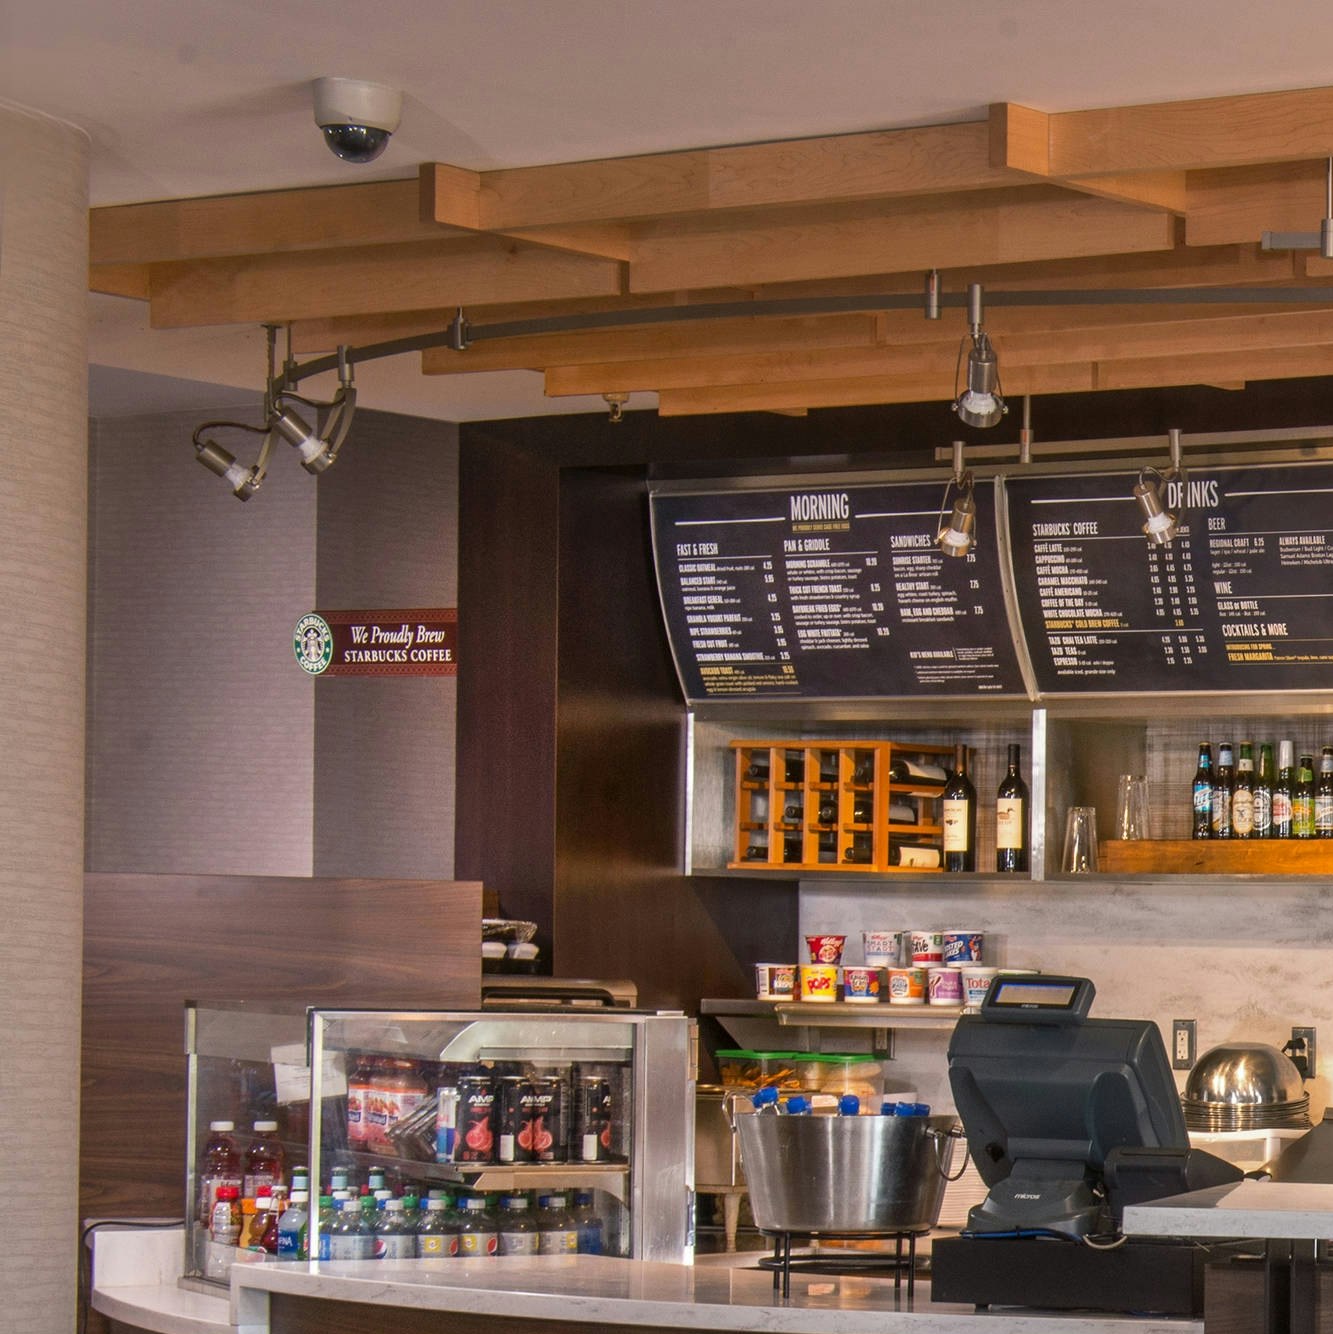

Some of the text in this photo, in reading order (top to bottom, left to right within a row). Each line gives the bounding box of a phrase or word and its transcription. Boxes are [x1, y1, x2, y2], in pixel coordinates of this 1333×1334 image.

[790, 493, 849, 521] MORNING
[1073, 522, 1098, 535] COFFEE
[1208, 518, 1226, 531] BEER
[784, 538, 831, 553] PAN & GRIDDLE
[890, 534, 931, 548] SANDWICHES
[1234, 537, 1250, 547] CRAFT
[677, 542, 719, 557] FAST FRESH
[1213, 581, 1233, 594] WINE
[294, 616, 330, 641] STARBUCKS
[1222, 622, 1288, 637] COCKTAILS & MORE
[351, 624, 445, 649] We Proudly Brew
[344, 649, 452, 663] STARBUCKS COFFEE
[300, 656, 328, 672] COFFEE
[965, 977, 990, 988] Tota
[468, 1095, 494, 1103] AMP
